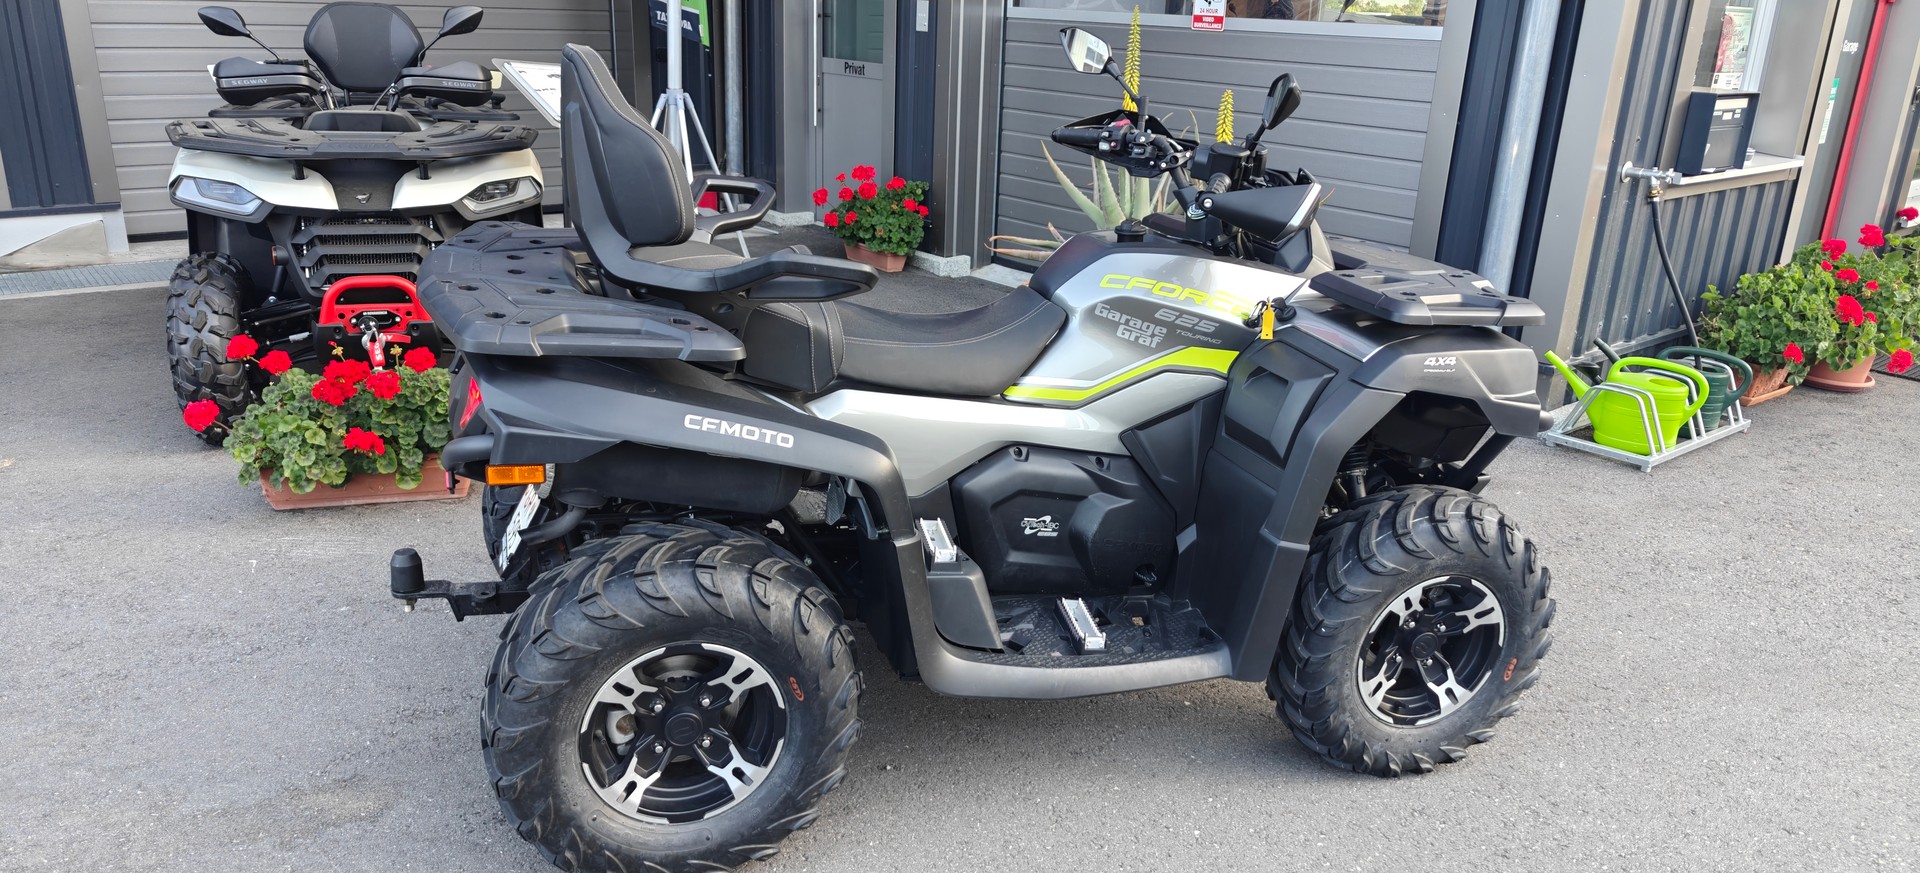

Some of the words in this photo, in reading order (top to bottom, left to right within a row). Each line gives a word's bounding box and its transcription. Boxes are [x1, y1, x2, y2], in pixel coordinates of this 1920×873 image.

[844, 61, 866, 76] Privat
[231, 78, 268, 86] SEGWAY
[1100, 273, 1252, 320] CFORCE
[1094, 302, 1168, 335] Garage
[1154, 307, 1219, 333] 625
[1116, 324, 1163, 349] Graf
[1175, 329, 1222, 344] TOURING
[684, 414, 795, 448] CFMOTO
